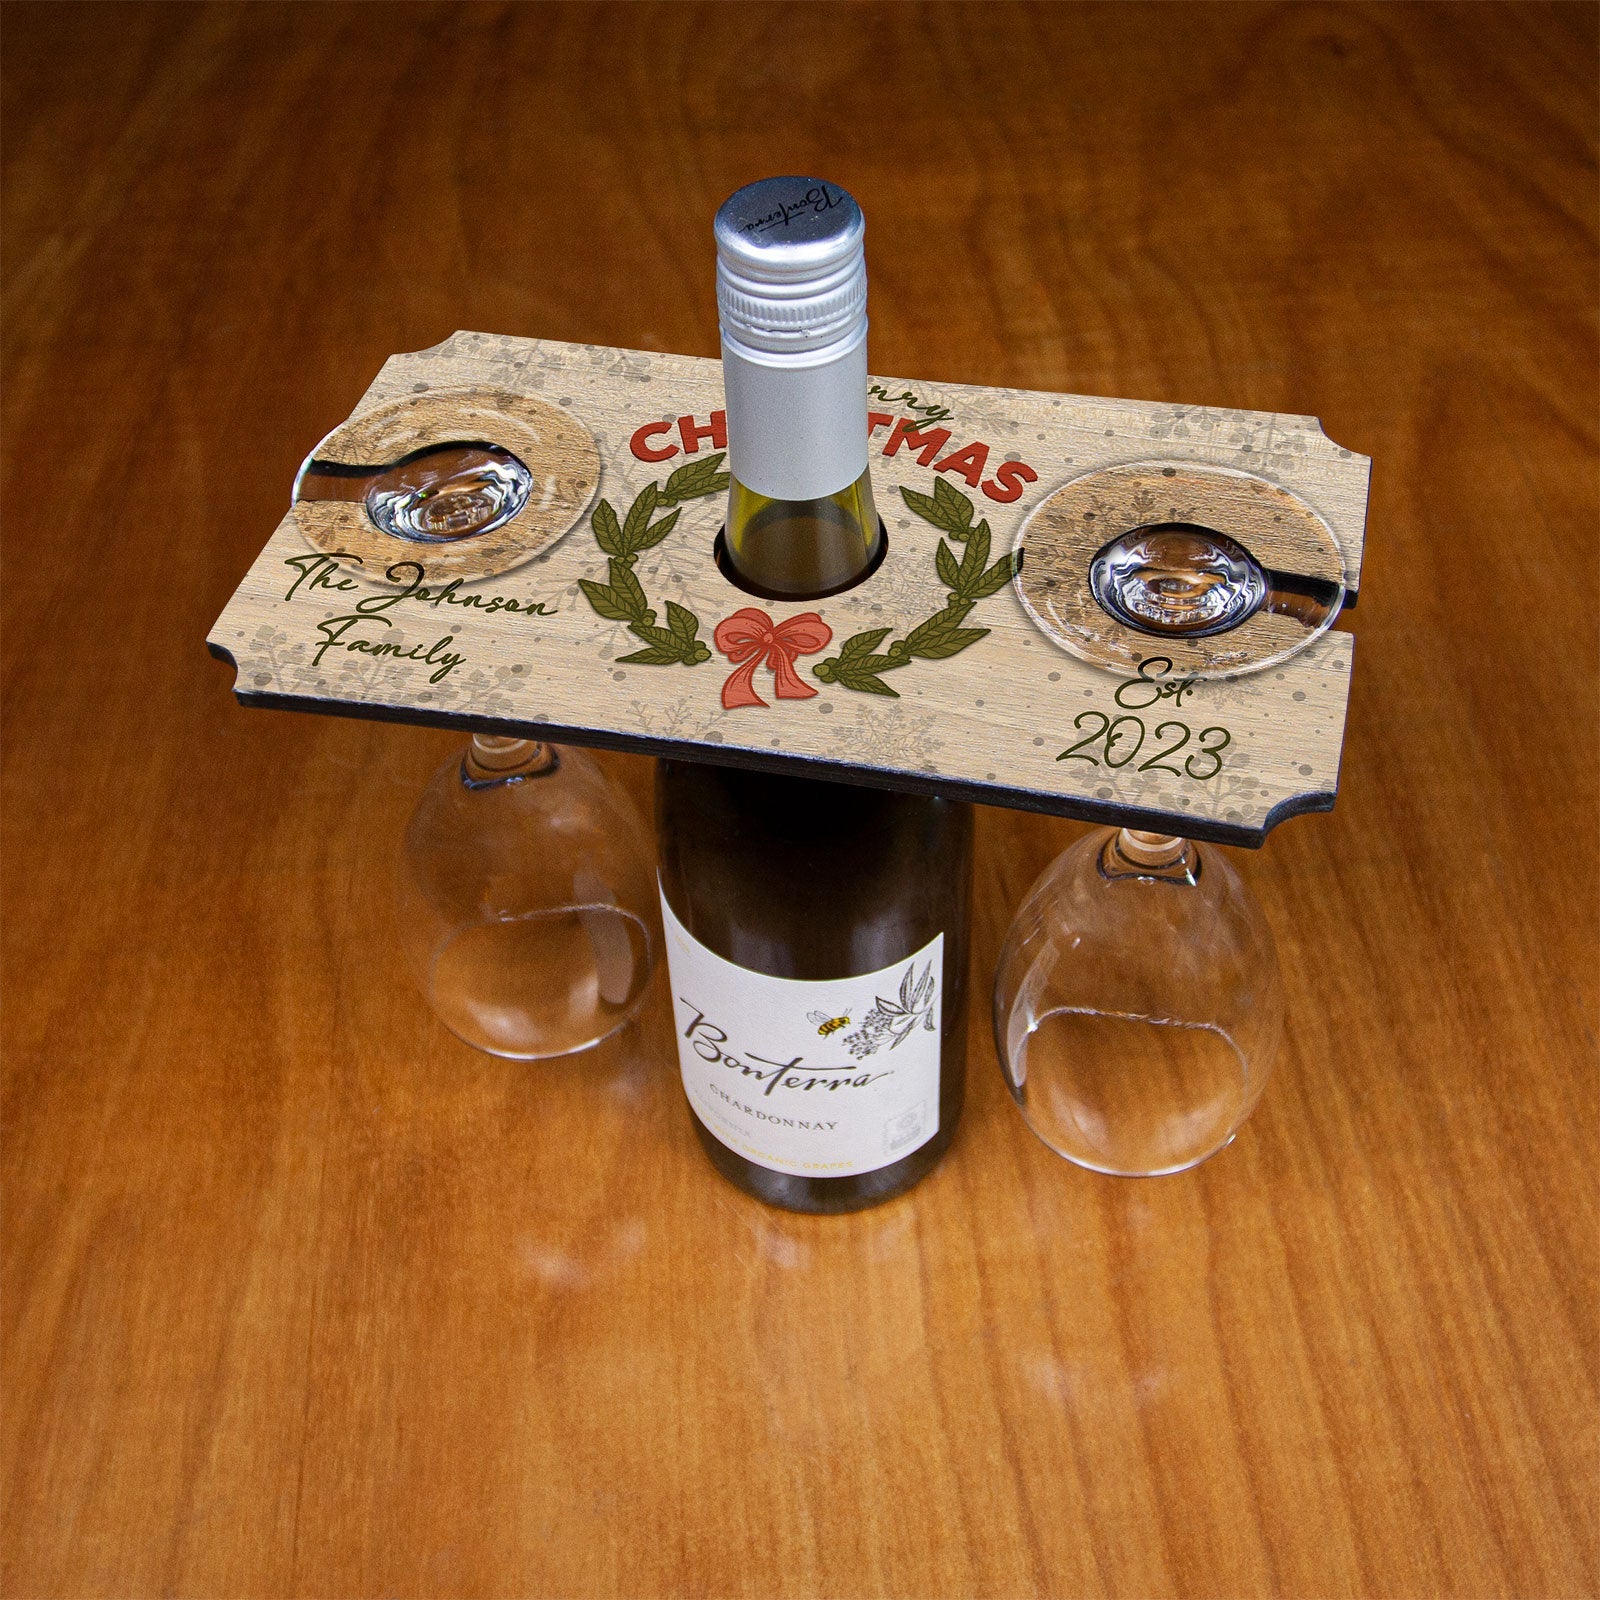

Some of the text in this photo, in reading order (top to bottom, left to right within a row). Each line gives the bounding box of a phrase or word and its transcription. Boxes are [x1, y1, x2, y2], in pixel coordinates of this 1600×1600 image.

[738, 185, 843, 234] Bonterra
[867, 385, 955, 432] rry
[629, 409, 1039, 504] CHTMAS
[284, 552, 558, 617] The Johnson
[312, 614, 467, 684] Family
[1114, 656, 1208, 710] Est.
[1055, 711, 1231, 780] 2023
[679, 997, 896, 1096] Bonterra
[709, 1083, 838, 1131] CHARDONNAY
